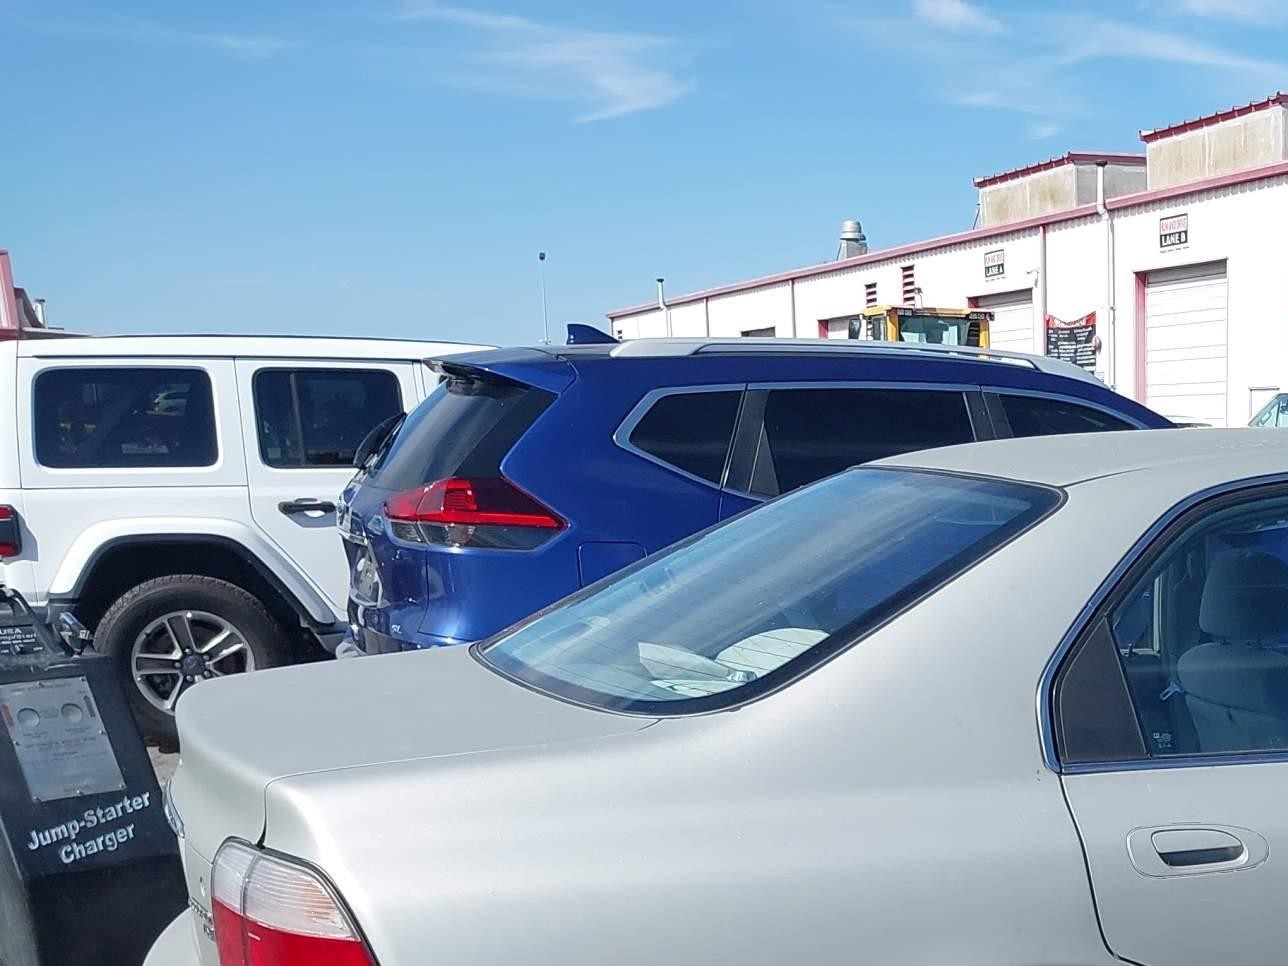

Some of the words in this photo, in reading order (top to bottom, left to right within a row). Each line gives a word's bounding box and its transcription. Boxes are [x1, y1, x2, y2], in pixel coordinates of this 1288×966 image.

[1161, 232, 1180, 246] LANE
[1180, 231, 1186, 243] B
[28, 791, 150, 850] Jump-Starter
[60, 823, 135, 864] Charger
